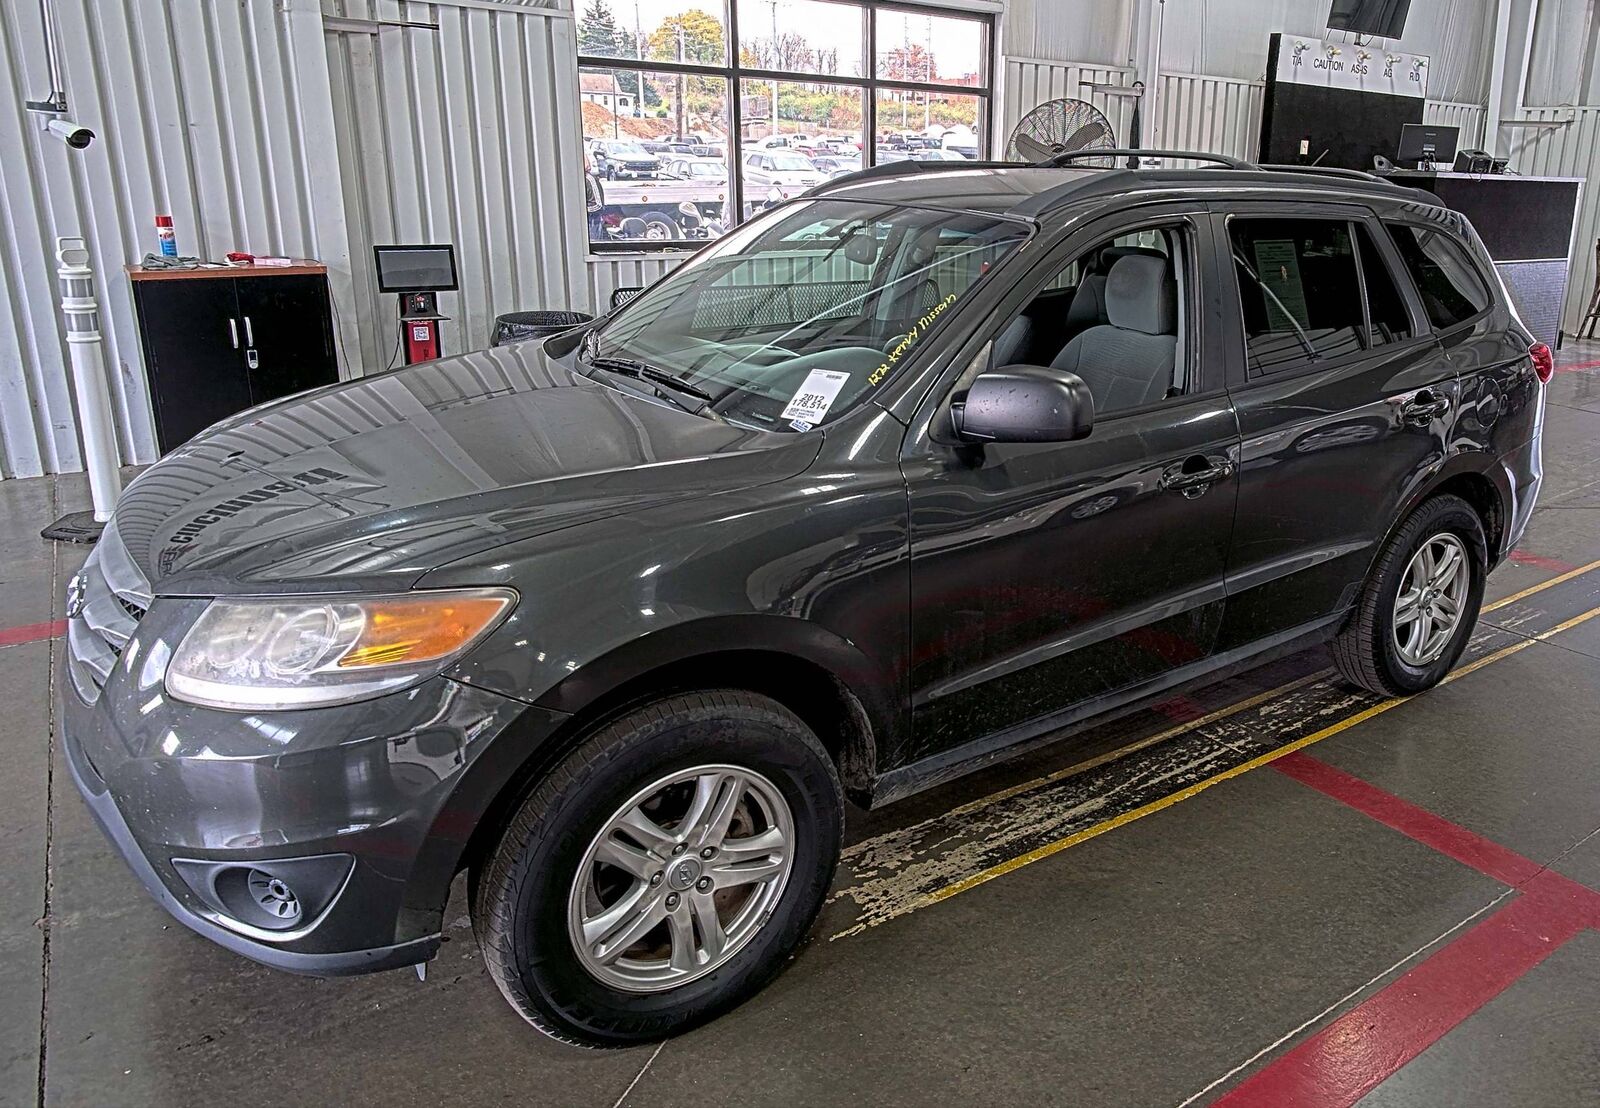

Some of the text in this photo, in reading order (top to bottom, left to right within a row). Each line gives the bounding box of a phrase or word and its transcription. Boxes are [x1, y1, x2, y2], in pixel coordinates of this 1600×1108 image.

[1313, 58, 1344, 72] CAUTION
[1351, 64, 1368, 75] AS-IS
[1383, 68, 1393, 78] AG
[792, 398, 828, 410] 178,514
[802, 393, 825, 403] 2012
